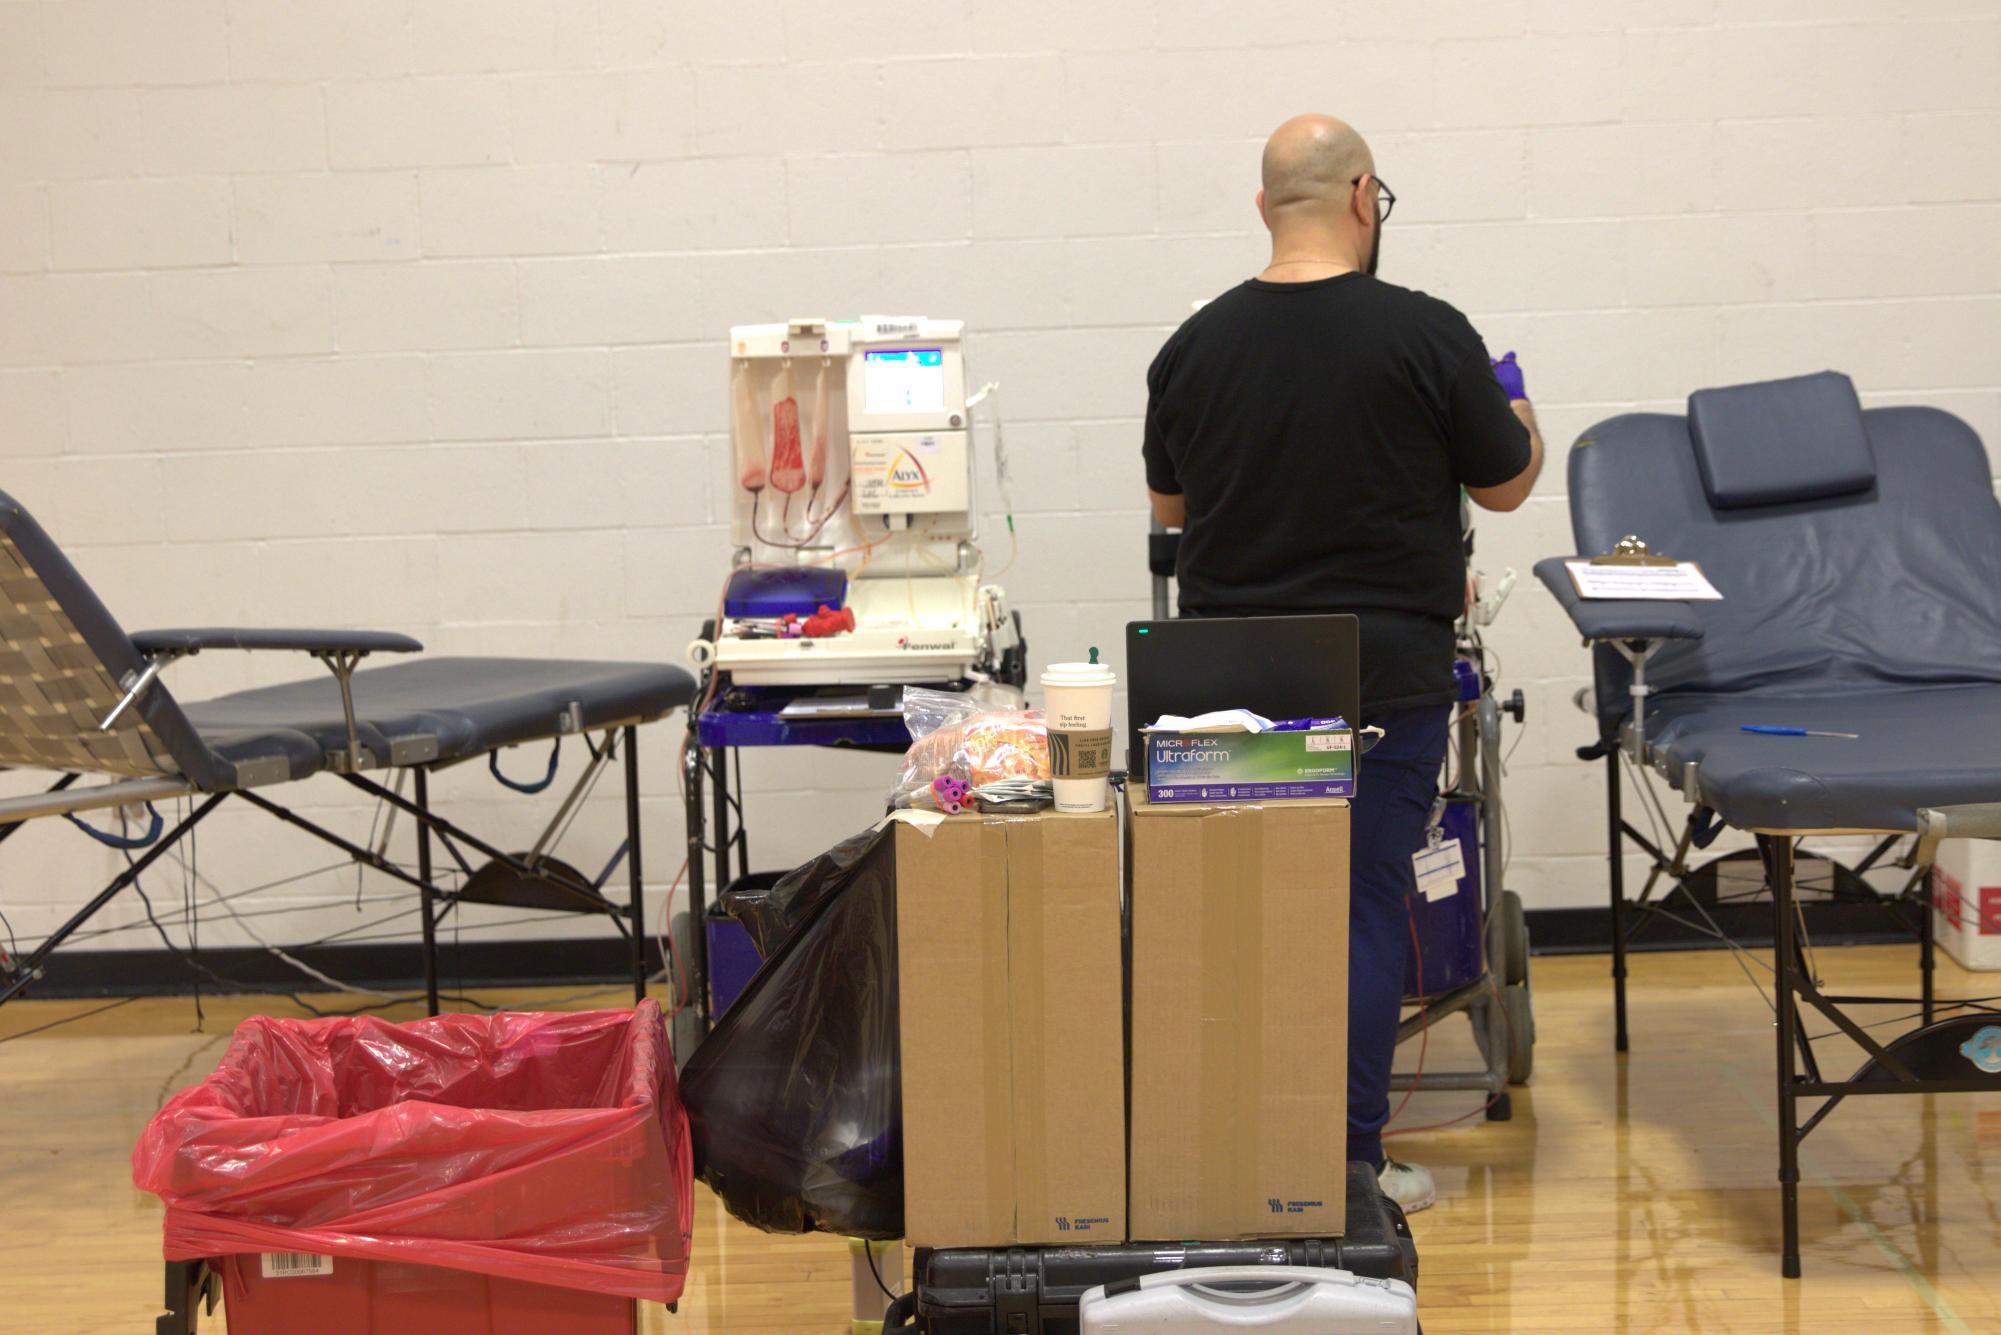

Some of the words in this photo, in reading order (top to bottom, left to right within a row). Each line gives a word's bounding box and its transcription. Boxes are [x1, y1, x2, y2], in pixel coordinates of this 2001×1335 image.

[1156, 739, 1218, 748] MICROFLEX
[1156, 749, 1230, 763] Ultraform
[1158, 789, 1174, 799] 300
